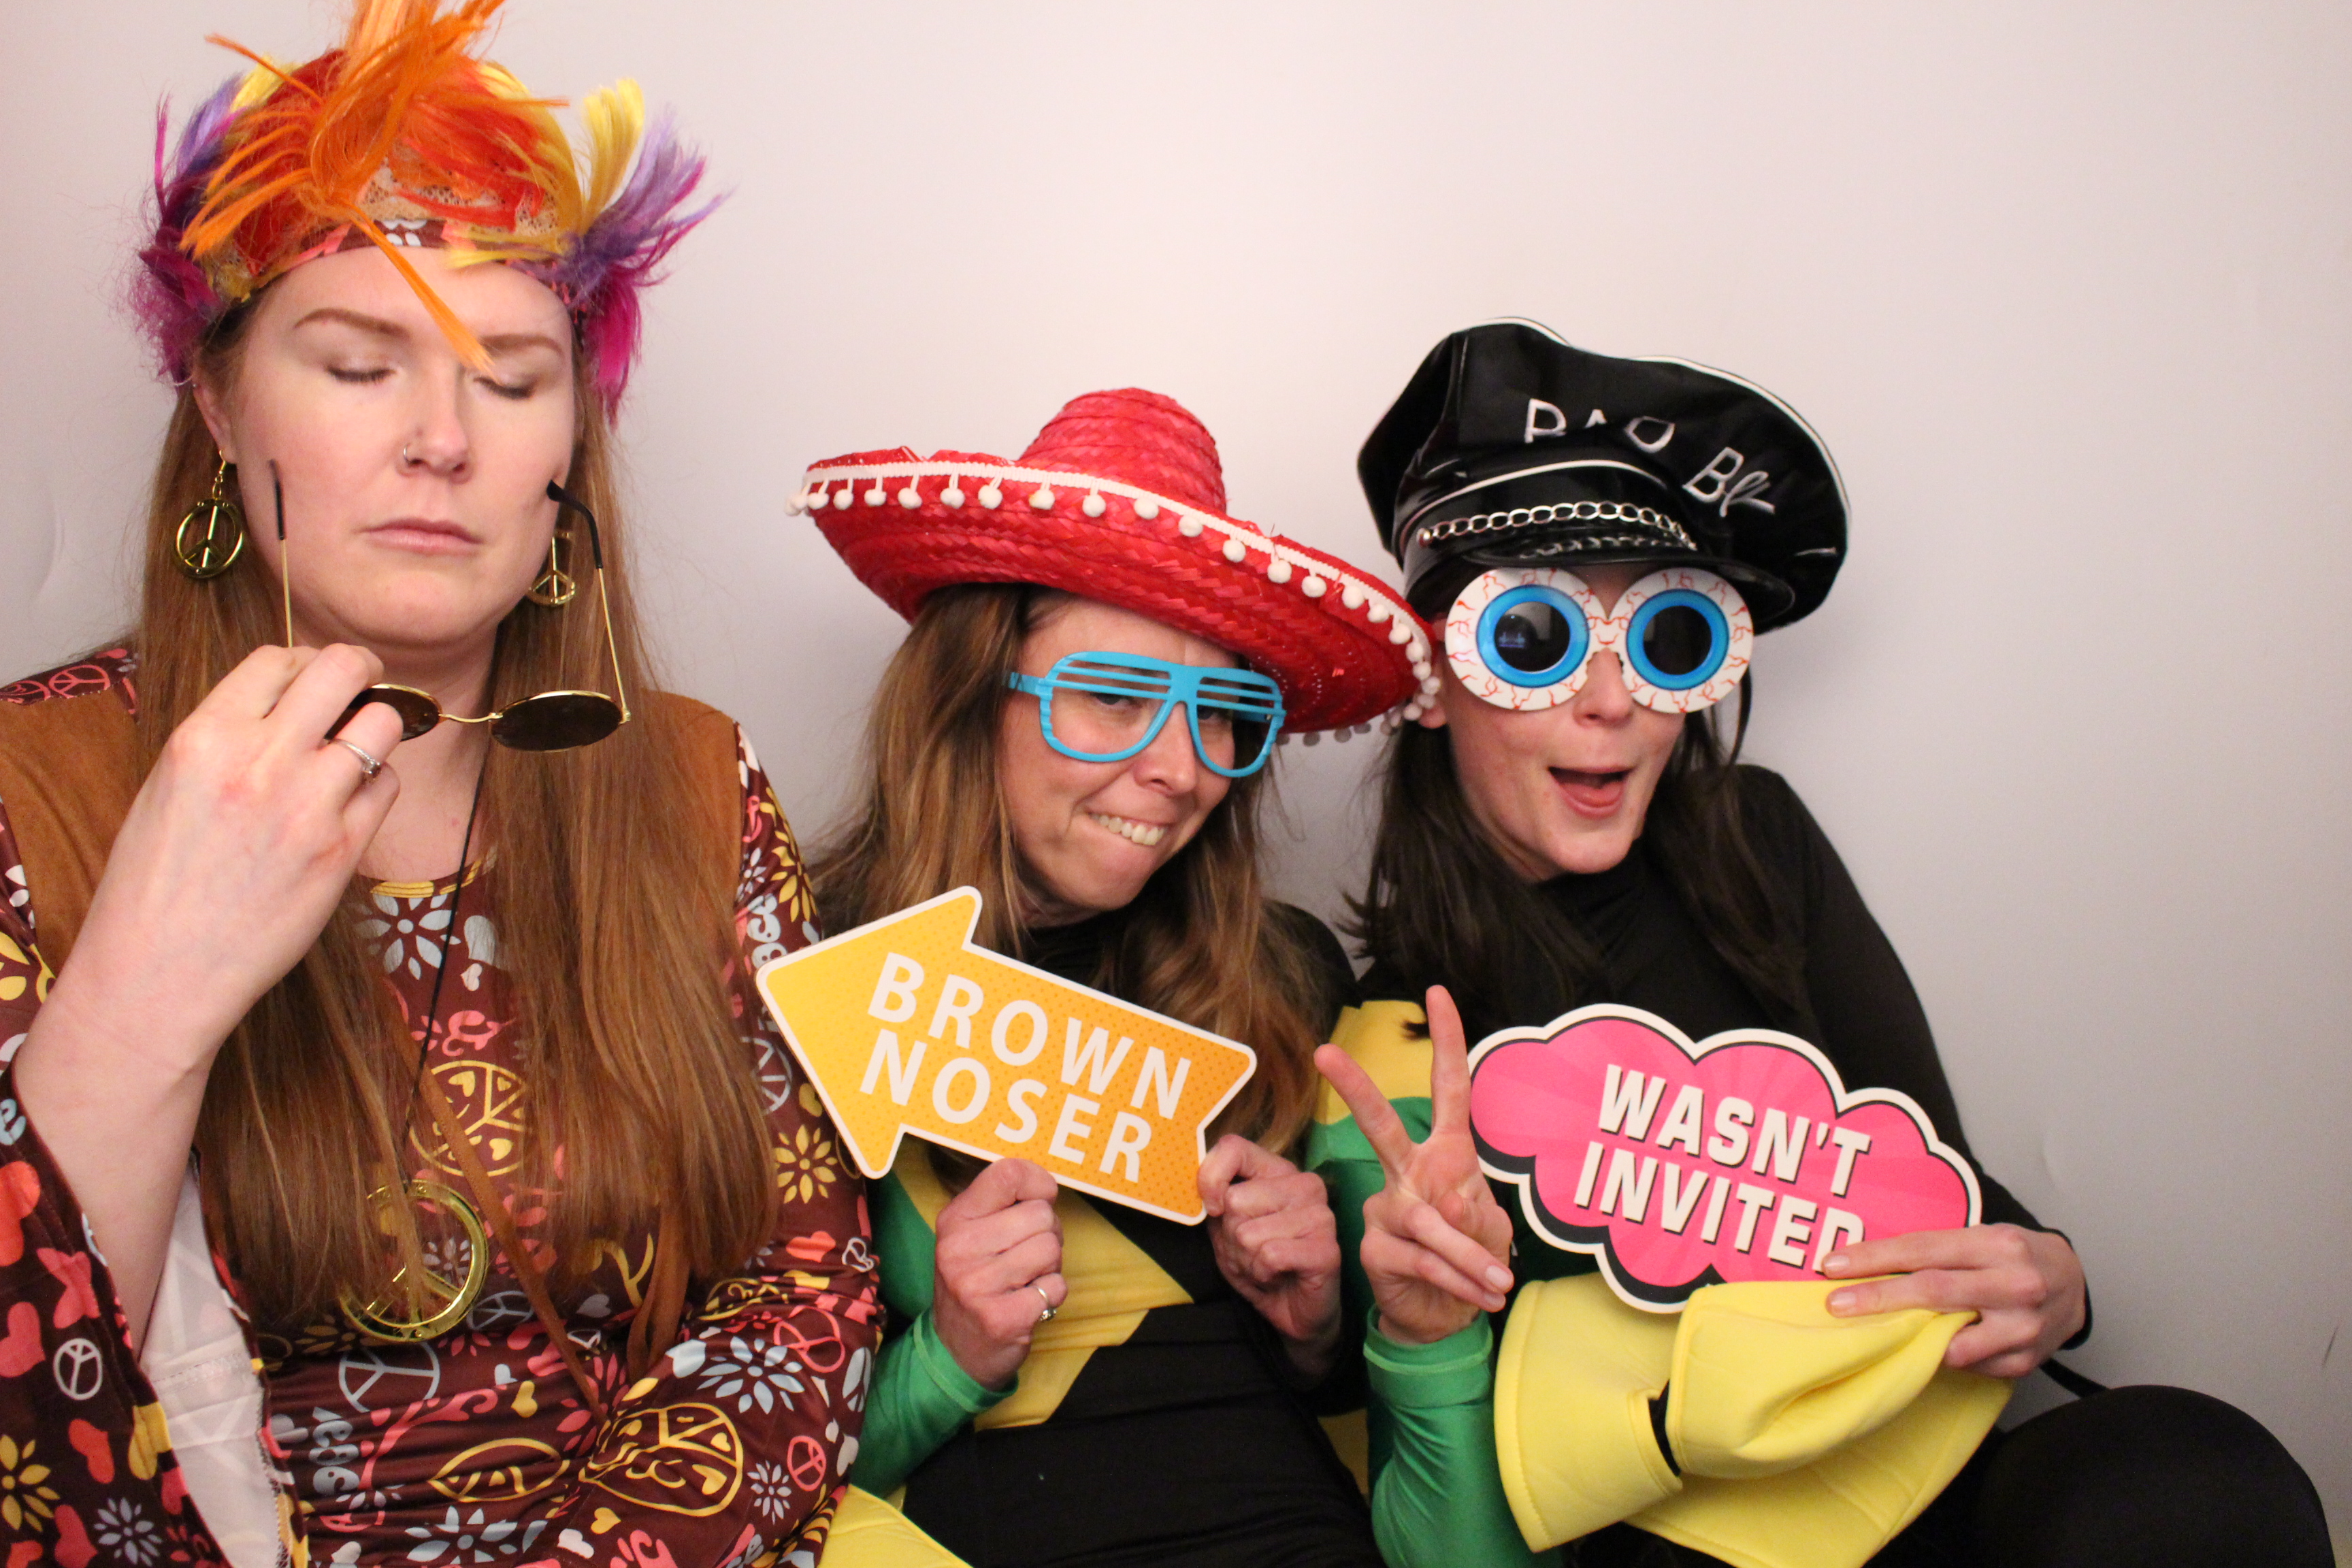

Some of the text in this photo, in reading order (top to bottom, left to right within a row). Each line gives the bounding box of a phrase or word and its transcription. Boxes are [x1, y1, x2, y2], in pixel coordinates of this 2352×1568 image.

[860, 1028, 1153, 1183] NOSER
[868, 953, 1191, 1120] BROWN
[1598, 1064, 1871, 1196] WASN'T
[1573, 1141, 1865, 1273] INVITED
